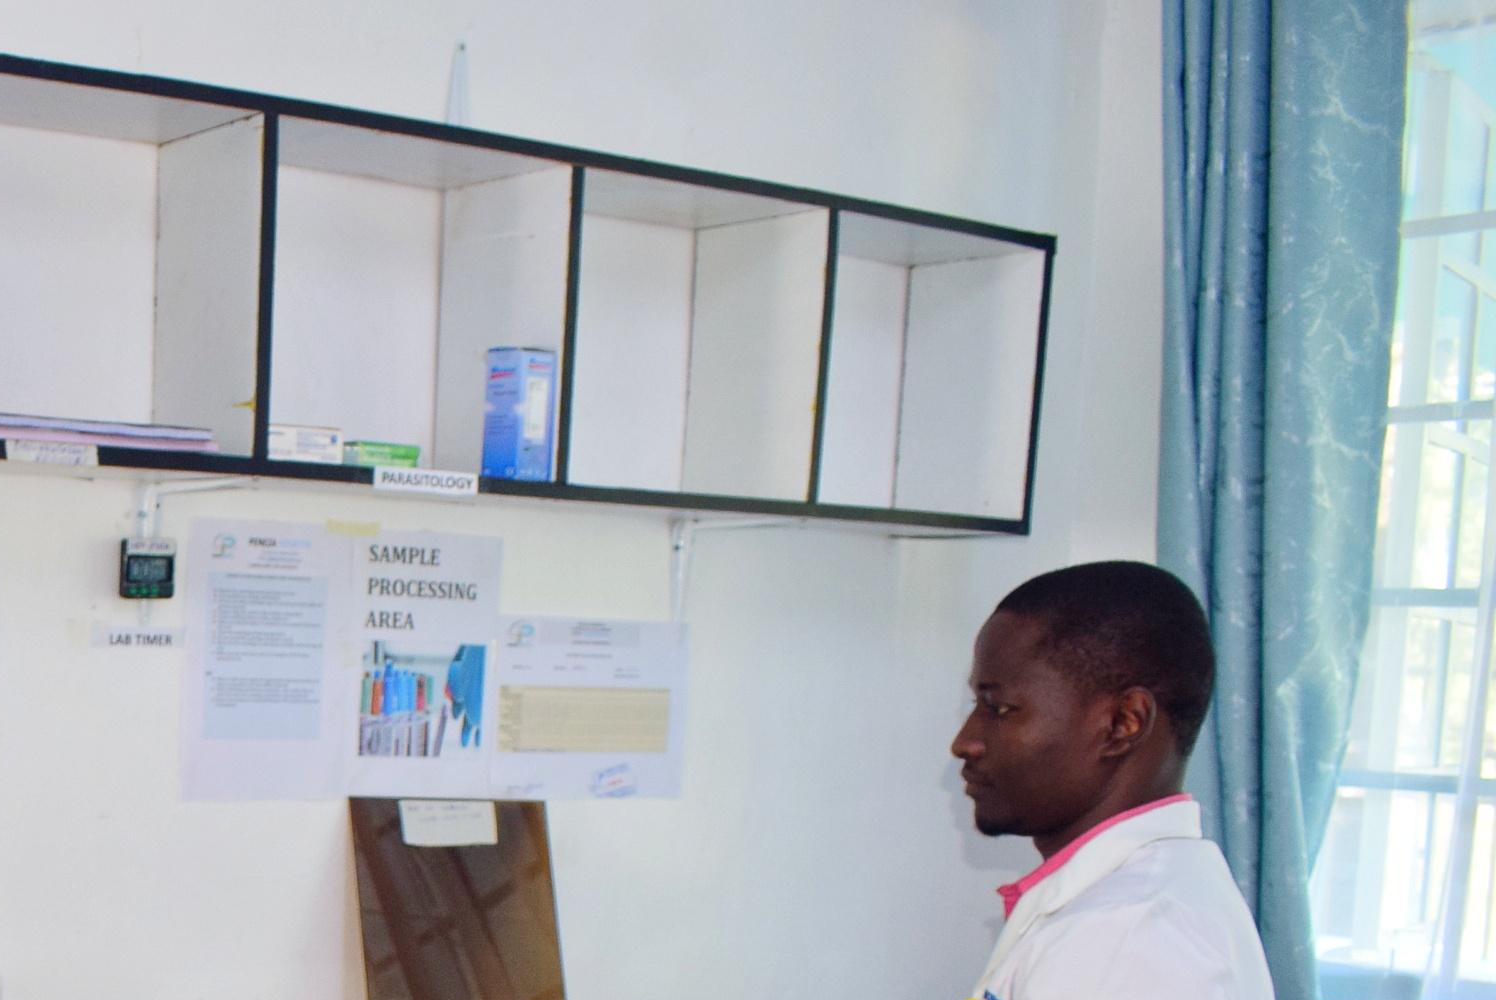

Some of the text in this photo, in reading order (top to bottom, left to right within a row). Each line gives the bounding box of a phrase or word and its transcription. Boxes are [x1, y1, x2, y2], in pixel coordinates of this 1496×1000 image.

[381, 471, 474, 490] PARASITOLOGY
[368, 543, 442, 567] SAMPLE
[367, 577, 478, 601] PROCESSING
[365, 610, 415, 630] AREA
[109, 633, 173, 646] LAB TIMER
